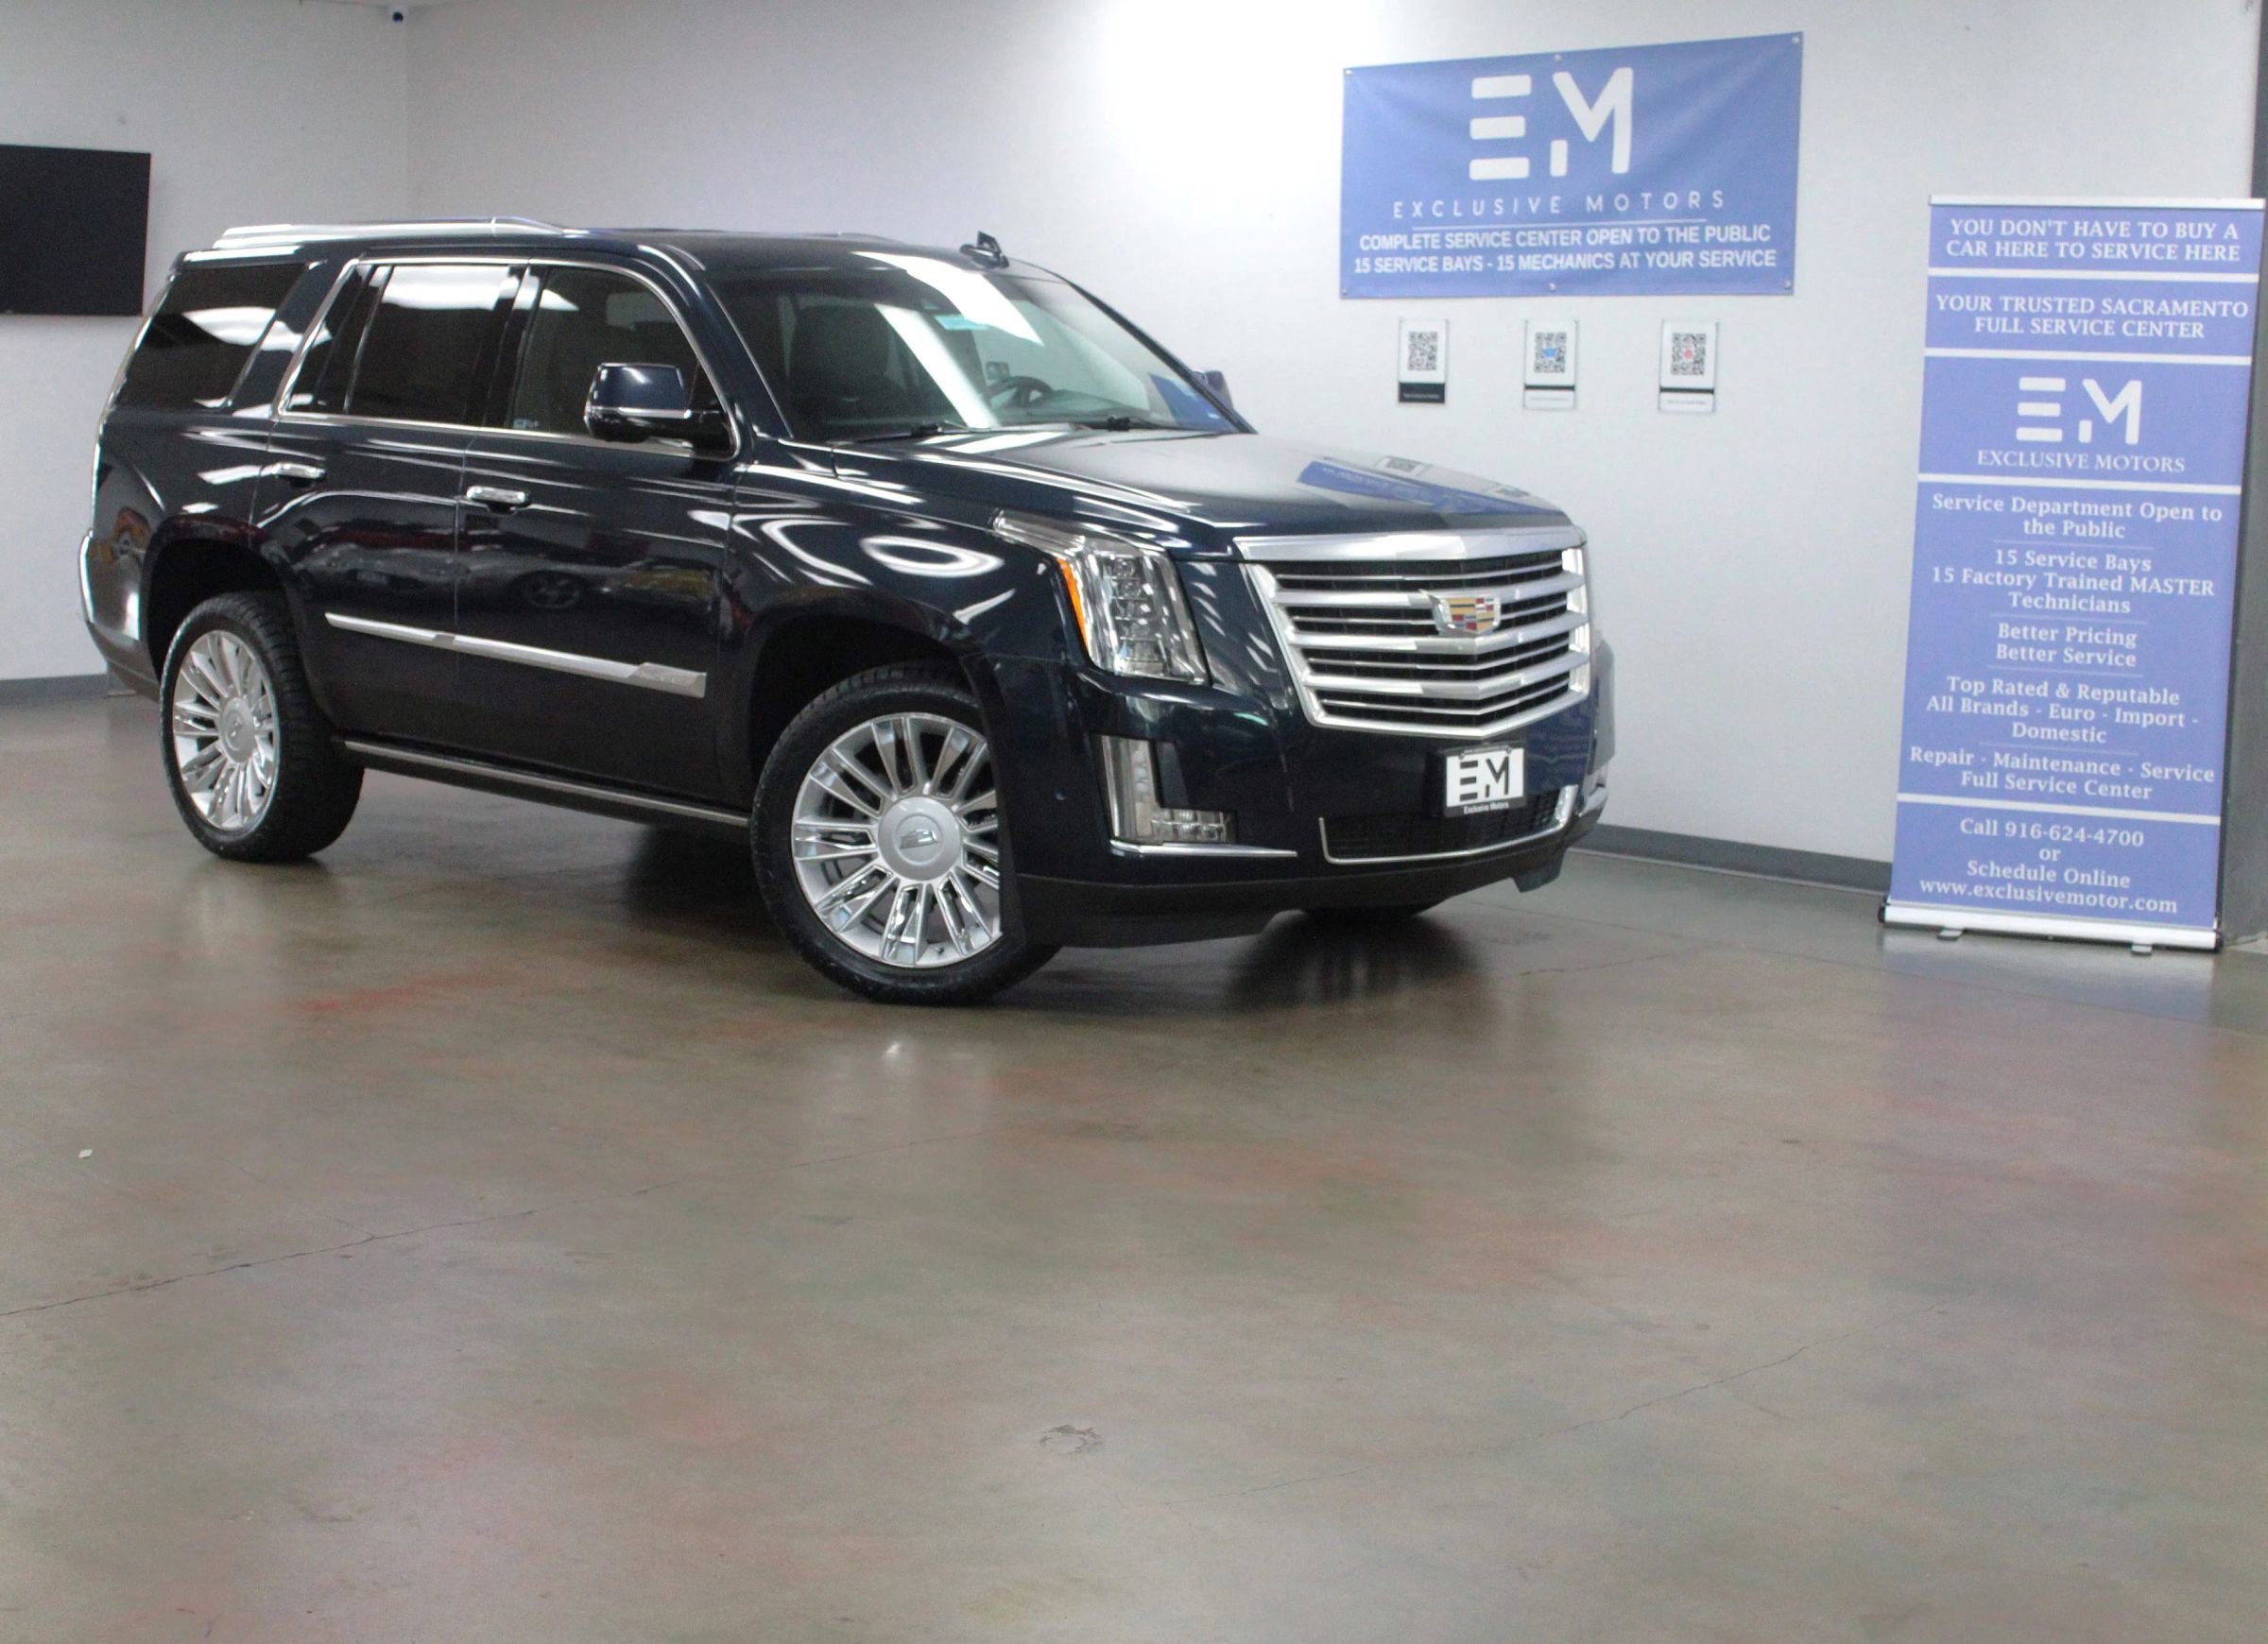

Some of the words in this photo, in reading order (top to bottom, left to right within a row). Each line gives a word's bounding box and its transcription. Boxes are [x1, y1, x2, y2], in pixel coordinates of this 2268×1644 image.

[1469, 67, 1633, 180] EM
[1393, 197, 1561, 219] EXCLUSIVE
[1586, 190, 1725, 214] MOTORS
[1360, 231, 1440, 250] COMPLETE
[1445, 230, 1512, 248] SERVICE
[1516, 230, 1581, 248] CENTER
[1586, 228, 1633, 246] OPEN
[1639, 227, 1660, 244] TO
[1666, 226, 1699, 243] THE
[1705, 225, 1771, 243] PUBLIC
[1950, 218, 1993, 236] YOU
[2001, 219, 2068, 237] DON'T
[2074, 220, 2130, 238] HAVE
[2138, 222, 2168, 239] TO
[2175, 223, 2217, 240] BUY
[2224, 224, 2239, 240] A
[1354, 258, 1370, 273] 15
[1374, 256, 1439, 273] SERVICE
[1442, 255, 1484, 273] BAYS
[1497, 256, 1514, 270] 15
[1519, 252, 1615, 271] MECHANICS
[1619, 252, 1638, 268] AT
[1644, 251, 1693, 268] YOUR
[1699, 249, 1777, 267] SERVICE
[1947, 240, 1988, 257] CAR
[1995, 241, 2049, 258] HERE
[2055, 243, 2085, 259] TO
[2091, 244, 2177, 261] SERVICE
[2184, 246, 2241, 261] HERE
[1936, 295, 1991, 311] YOUR
[2000, 296, 2094, 315] TRUSTED
[2102, 299, 2248, 317] SACRAMENTO
[1974, 317, 2024, 334] FULL
[2030, 318, 2115, 336] SERVICE
[2122, 320, 2205, 338] CENTER
[2016, 377, 2142, 445] EM
[1977, 450, 2088, 469] EXCLUSIVE
[2095, 454, 2186, 472] MOTORS
[1933, 494, 2004, 512] Service
[2012, 497, 2133, 518] Department
[2140, 503, 2194, 522] Open
[2202, 505, 2223, 522] to
[2023, 518, 2056, 535] the
[2063, 521, 2125, 539] Public
[1995, 550, 2018, 565] 15
[2025, 551, 2097, 570] Service
[2105, 555, 2152, 572] Bays
[1933, 568, 1954, 583] 15
[1962, 569, 2036, 588] Factory
[2043, 573, 2122, 591] Trained
[2130, 577, 2214, 596] MASTER
[2008, 592, 2130, 612] Technicians
[1999, 624, 2059, 642] Better
[2066, 627, 2137, 647] Pricing
[1996, 644, 2056, 662] Better
[2063, 648, 2137, 667] Service
[1947, 676, 1984, 694] Top
[1992, 678, 2049, 697] Rated
[2056, 683, 2070, 698] &
[2077, 684, 2180, 706] Reputable
[1926, 696, 1953, 711] All
[1961, 698, 2029, 716] Brands
[2049, 704, 2095, 721] Euro
[2115, 708, 2186, 727] Import
[2012, 722, 2107, 744] Domestic
[1911, 746, 1974, 766] Repair
[1993, 752, 2121, 776] Maintenance
[2140, 762, 2215, 782] Service
[1961, 772, 1998, 789] Full
[2005, 775, 2077, 795] Service
[2084, 779, 2152, 799] Center
[1960, 818, 1999, 836] Call
[2005, 822, 2144, 847] 916-624-4700
[2038, 848, 2061, 861] or
[1967, 861, 2057, 882] Schedule
[2064, 868, 2130, 888] Online
[1920, 879, 2177, 914] www.exclusivemotor.com
